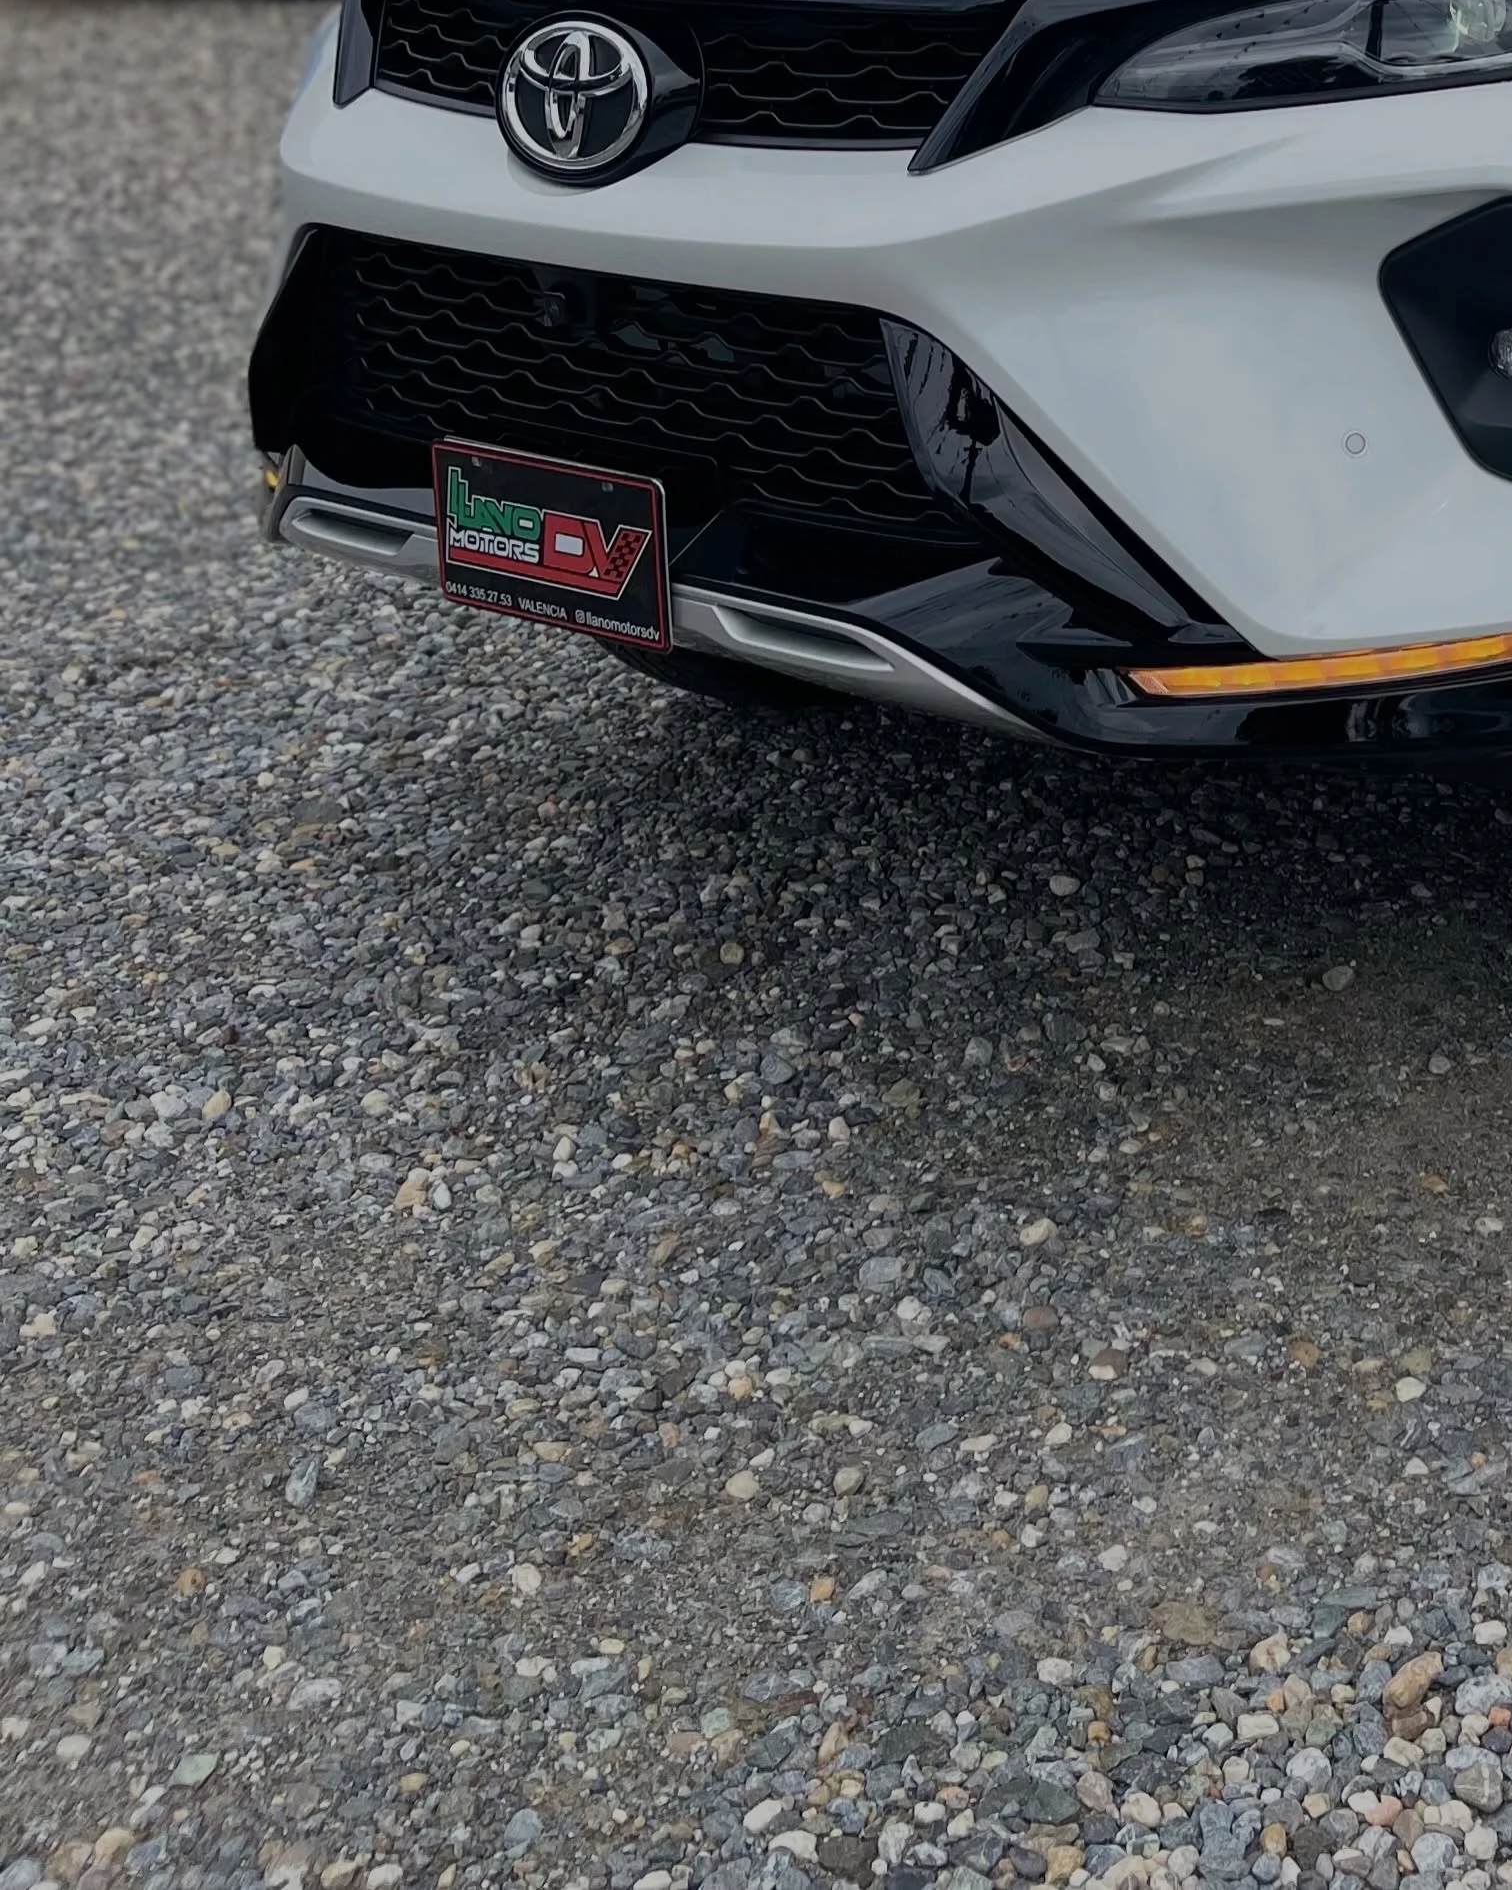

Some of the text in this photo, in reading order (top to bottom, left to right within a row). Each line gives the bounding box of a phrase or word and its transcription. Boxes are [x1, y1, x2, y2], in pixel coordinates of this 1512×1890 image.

[448, 466, 652, 582] LLANO DV
[449, 528, 540, 563] MOTORS
[446, 581, 467, 596] 0414
[518, 598, 567, 619] VALENCIA
